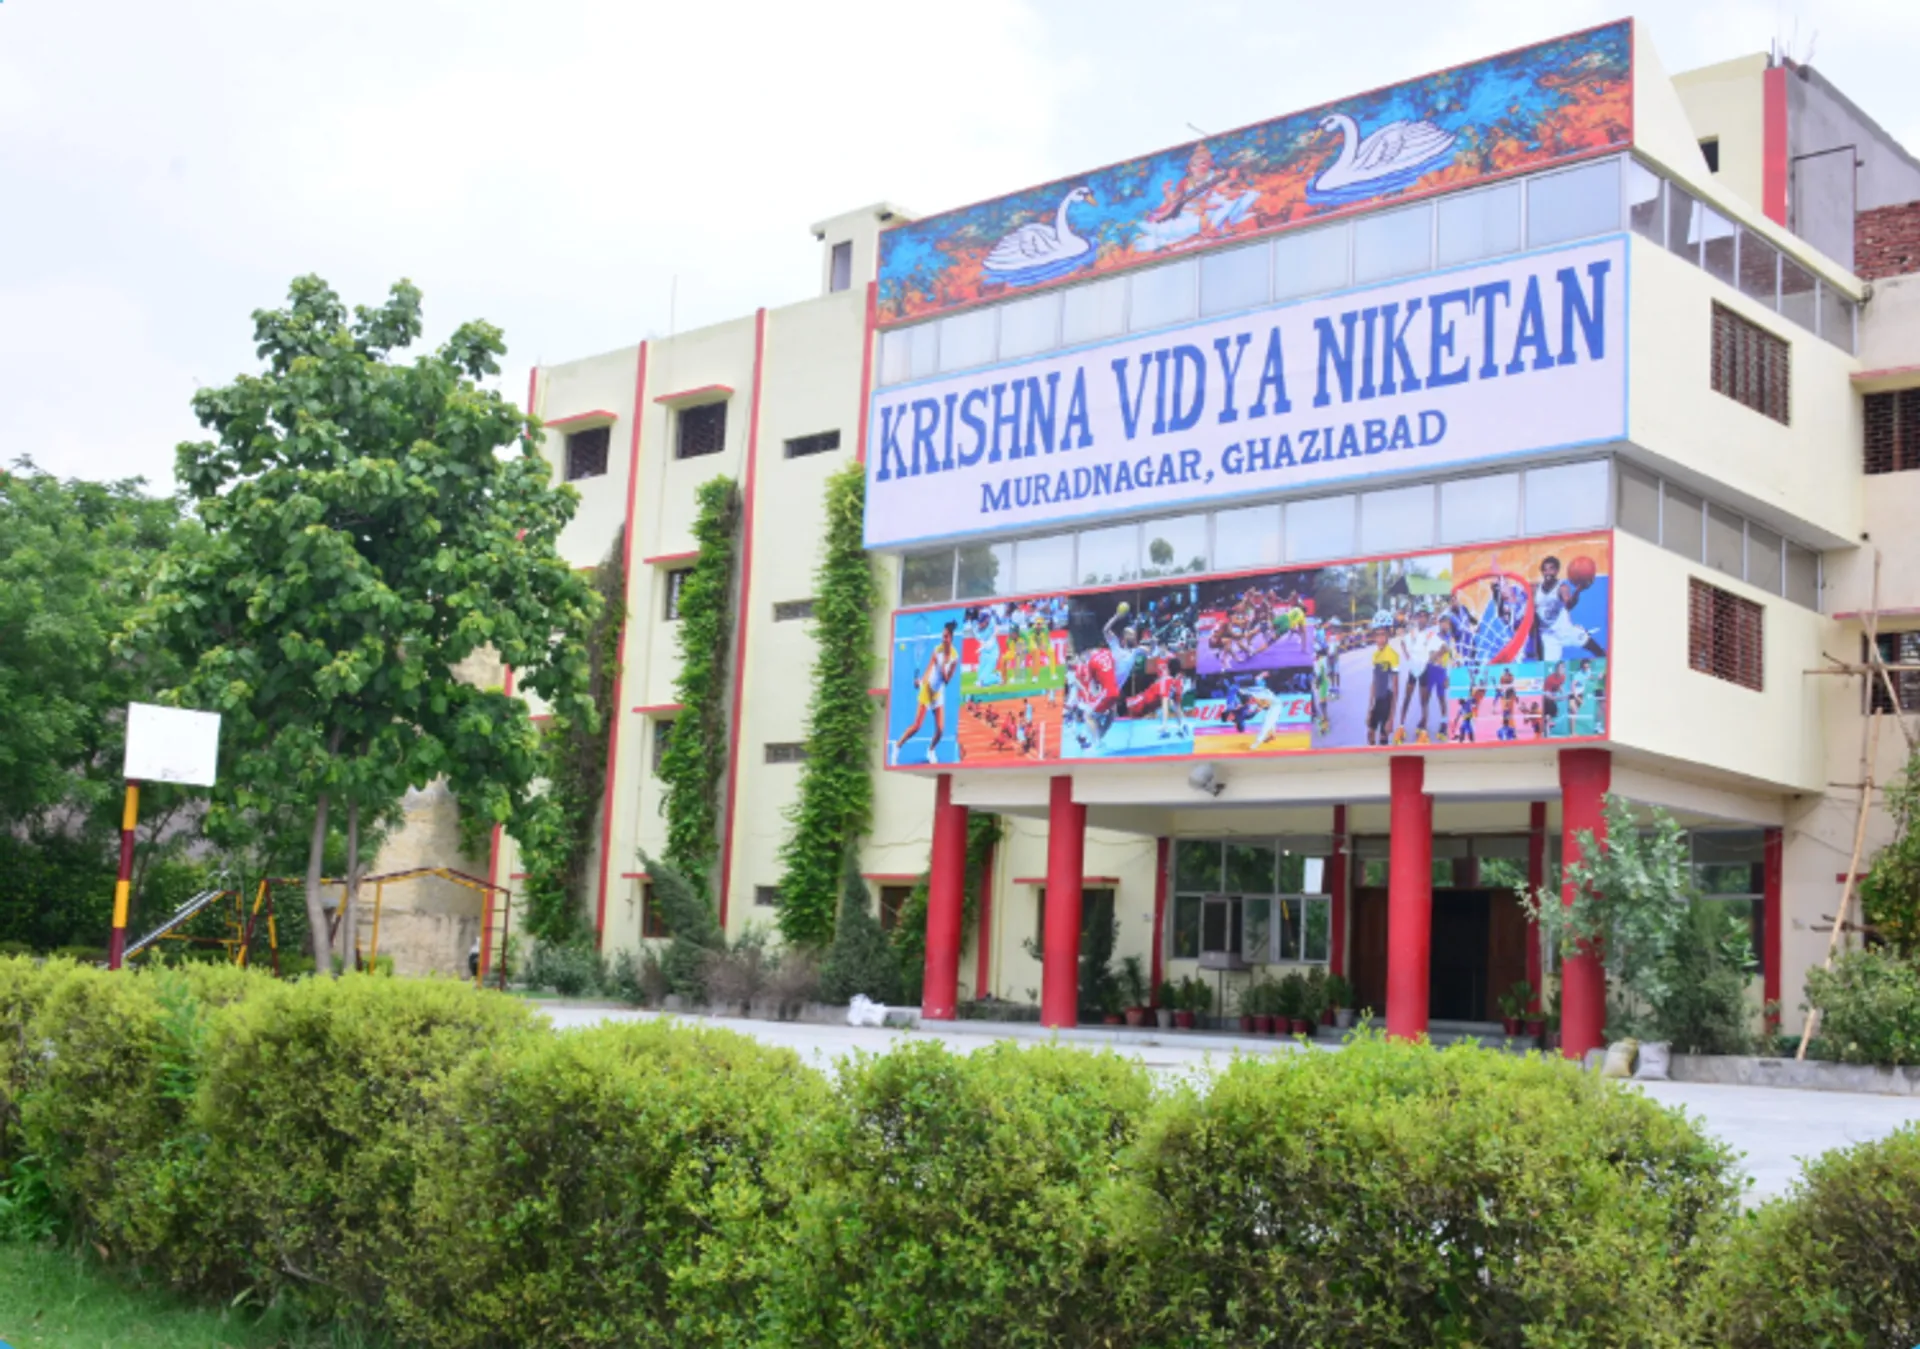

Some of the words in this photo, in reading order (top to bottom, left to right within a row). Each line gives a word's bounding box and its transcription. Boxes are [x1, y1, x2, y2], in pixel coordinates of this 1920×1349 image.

[875, 366, 1094, 482] KRISHNA
[1111, 326, 1292, 441] VIDYA
[1312, 259, 1612, 408] NIKETAN
[980, 448, 1215, 514] MURADNAGAR,
[1220, 409, 1448, 475] GHAZIABAD
